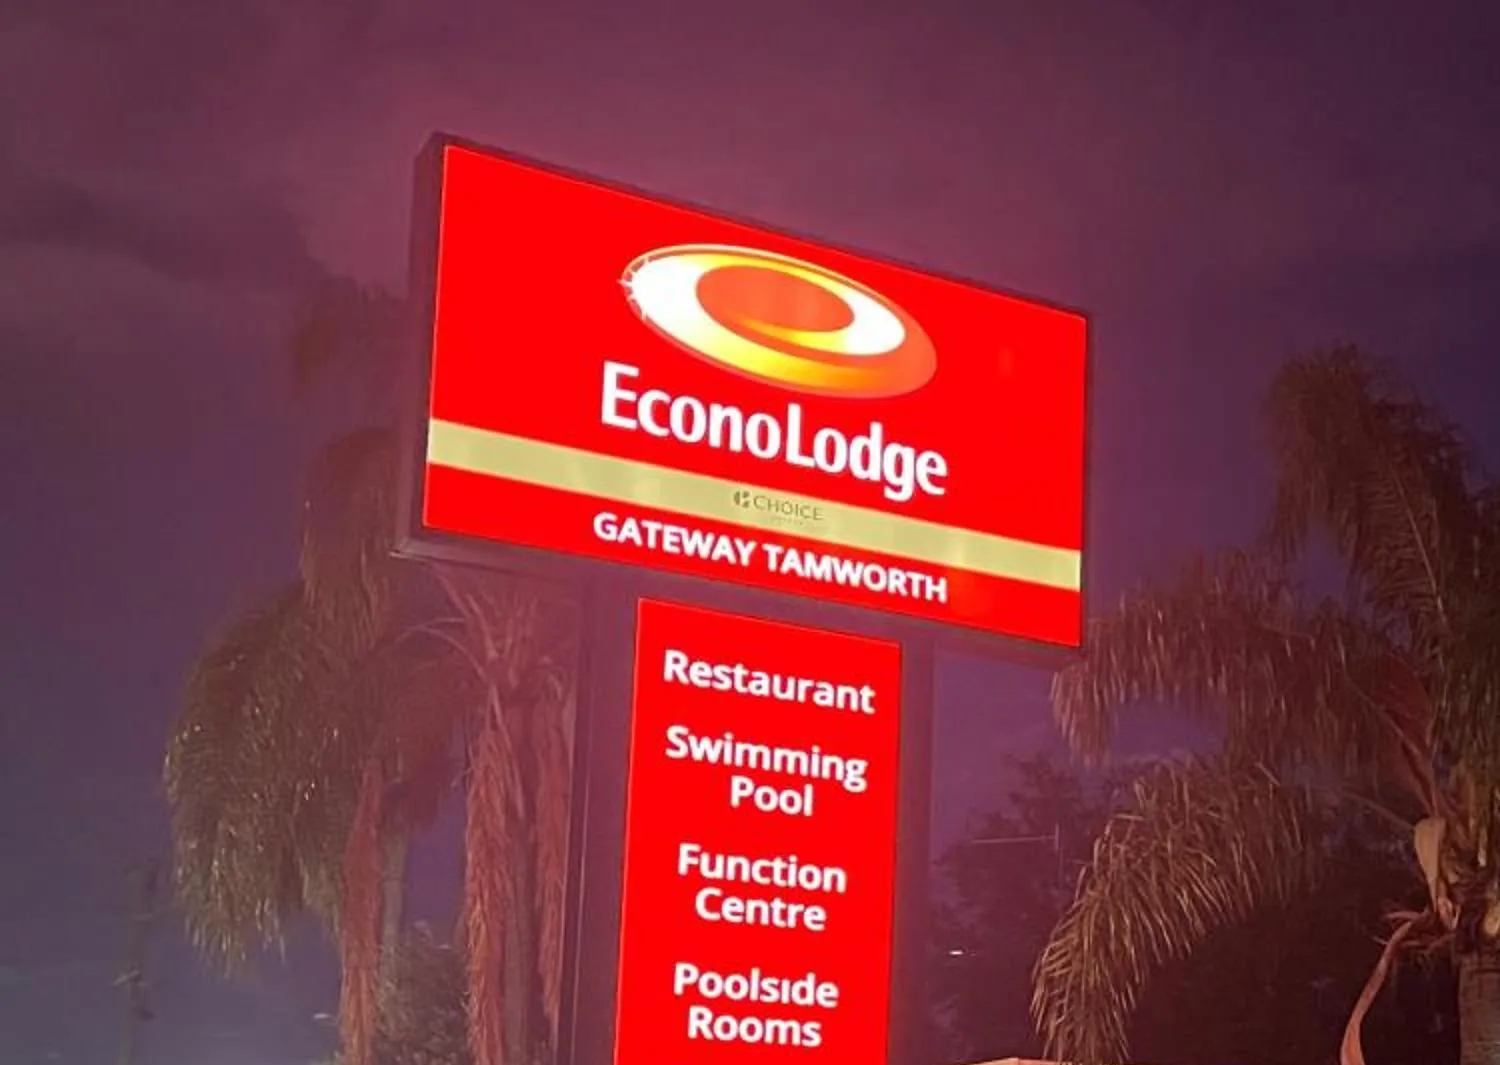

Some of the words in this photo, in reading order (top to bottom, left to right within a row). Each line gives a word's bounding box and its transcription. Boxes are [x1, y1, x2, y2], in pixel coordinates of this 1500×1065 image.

[601, 360, 948, 502] EconoLodge
[753, 495, 824, 521] CHOICE
[592, 510, 756, 567] GATEWAY
[761, 543, 948, 604] TAMWORTH
[663, 649, 876, 714] Restaurant
[665, 725, 868, 793] Swimming
[730, 775, 814, 816] Pool
[678, 842, 847, 893] Function
[694, 888, 826, 932] Centre
[673, 962, 839, 1008] Poolside
[687, 1006, 822, 1048] Rooms
